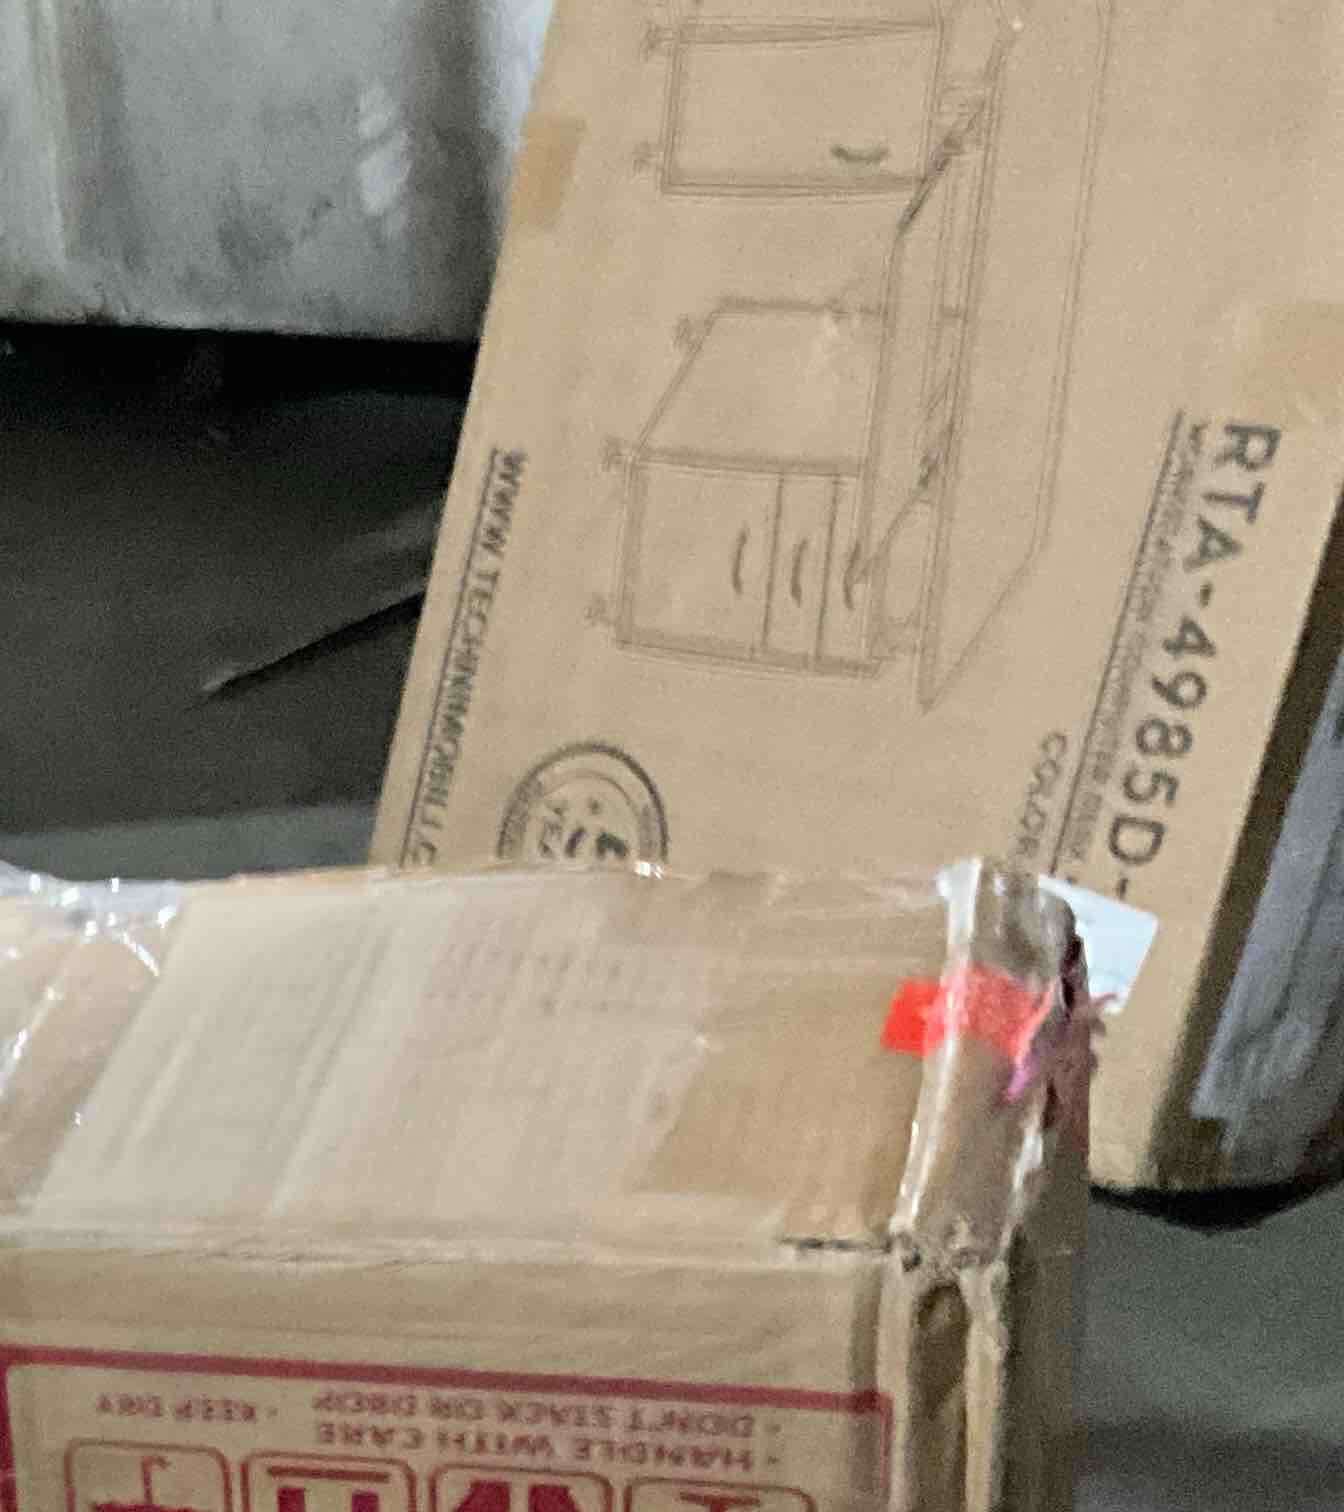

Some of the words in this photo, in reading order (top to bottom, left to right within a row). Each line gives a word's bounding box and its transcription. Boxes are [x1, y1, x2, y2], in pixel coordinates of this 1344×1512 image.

[1109, 423, 1282, 896] RTA-4985D-
[95, 1393, 163, 1418] DRY
[173, 1396, 259, 1424] KEEP
[313, 1391, 417, 1417] DROP
[430, 1398, 483, 1421] OR
[498, 1400, 615, 1429] STACK
[626, 1404, 755, 1438] DON'T
[317, 1422, 425, 1451] CARE
[436, 1431, 560, 1459] WITH
[572, 1437, 754, 1472] HANDLE
